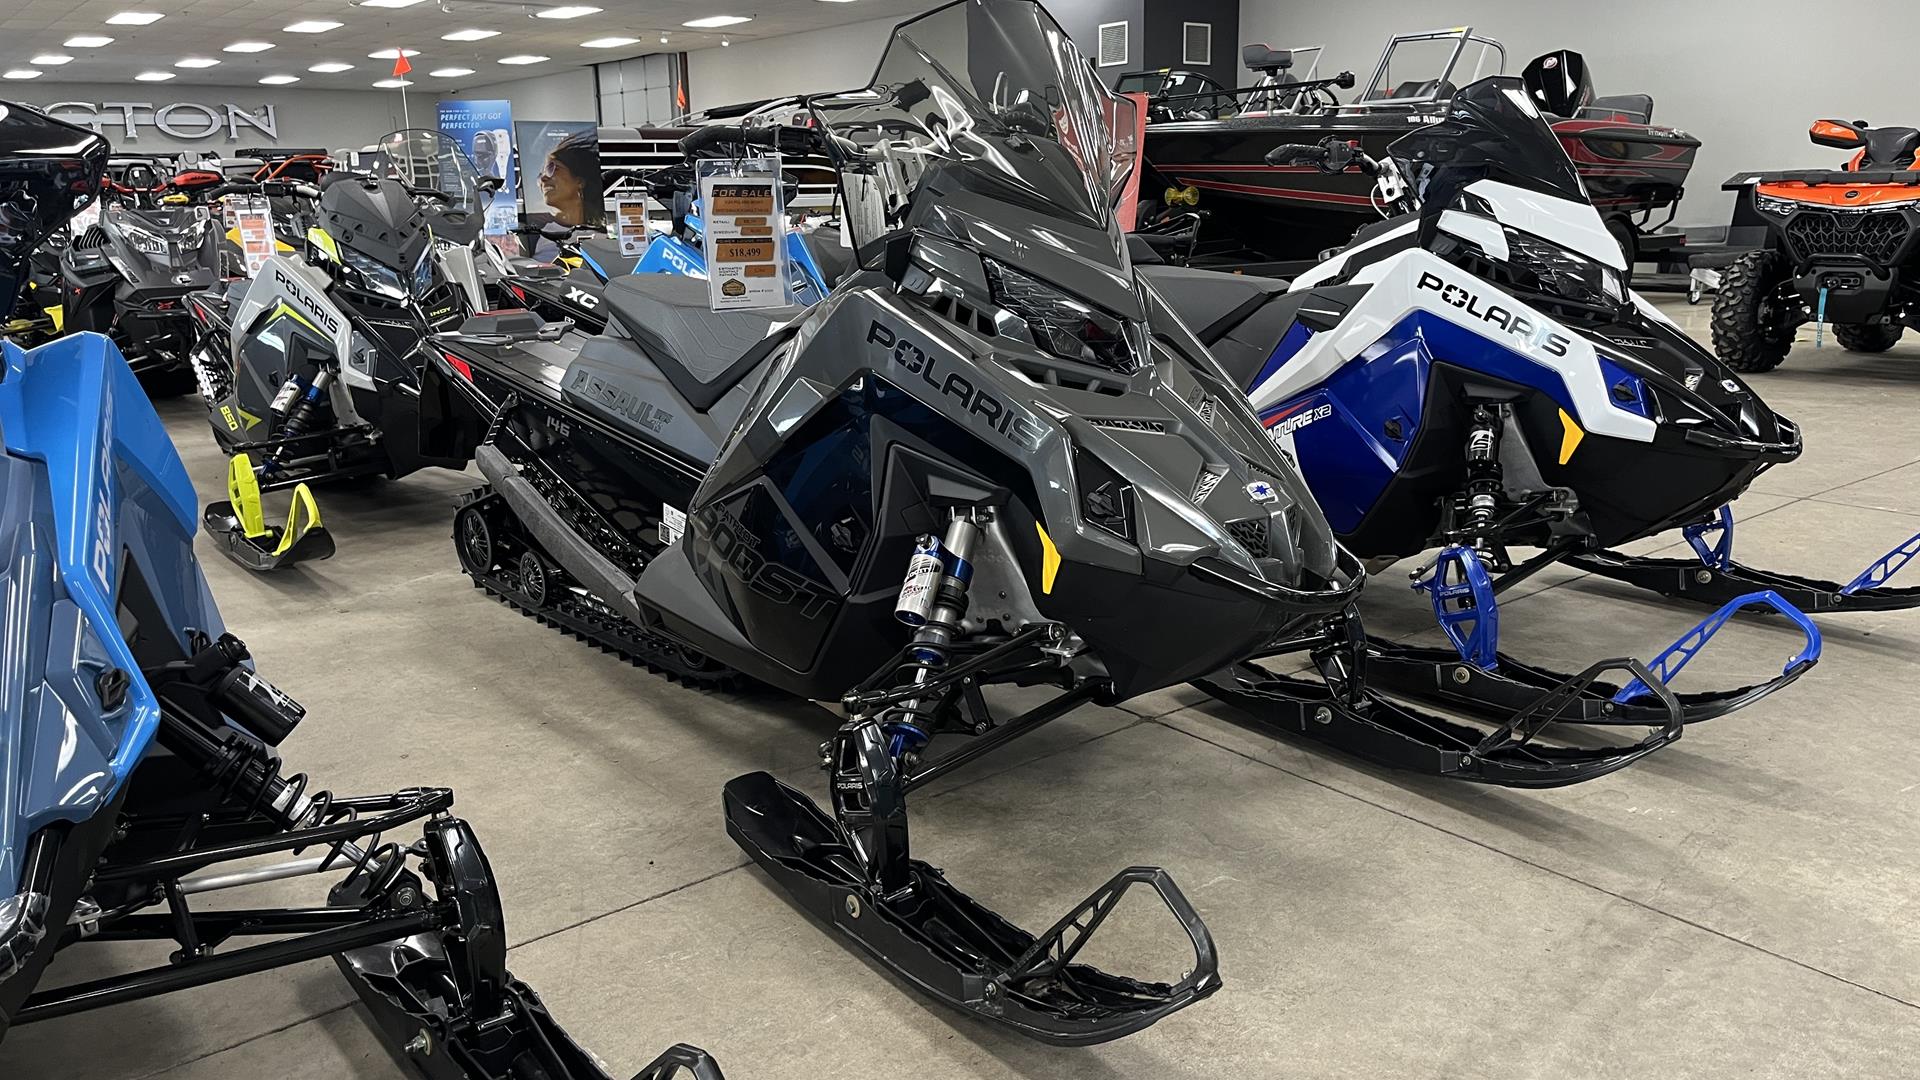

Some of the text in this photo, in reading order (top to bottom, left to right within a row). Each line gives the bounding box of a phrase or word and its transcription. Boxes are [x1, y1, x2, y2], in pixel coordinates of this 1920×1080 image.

[440, 112, 502, 121] PERFECT JUST GOT
[712, 189, 771, 197] FOR SALE
[729, 248, 761, 257] $18,499
[275, 269, 339, 335] POLARIS
[565, 286, 599, 310] XC
[429, 306, 452, 317] INDY
[1416, 271, 1571, 358] POLARIS
[866, 319, 1055, 452] POLARIS
[570, 369, 674, 434] ASSAULT
[1313, 403, 1332, 421] X2
[219, 404, 239, 432] 850
[546, 415, 571, 438] 146
[93, 388, 114, 595] POLARIS
[717, 501, 762, 550] PATRIOT
[836, 782, 863, 790] POLARIS
